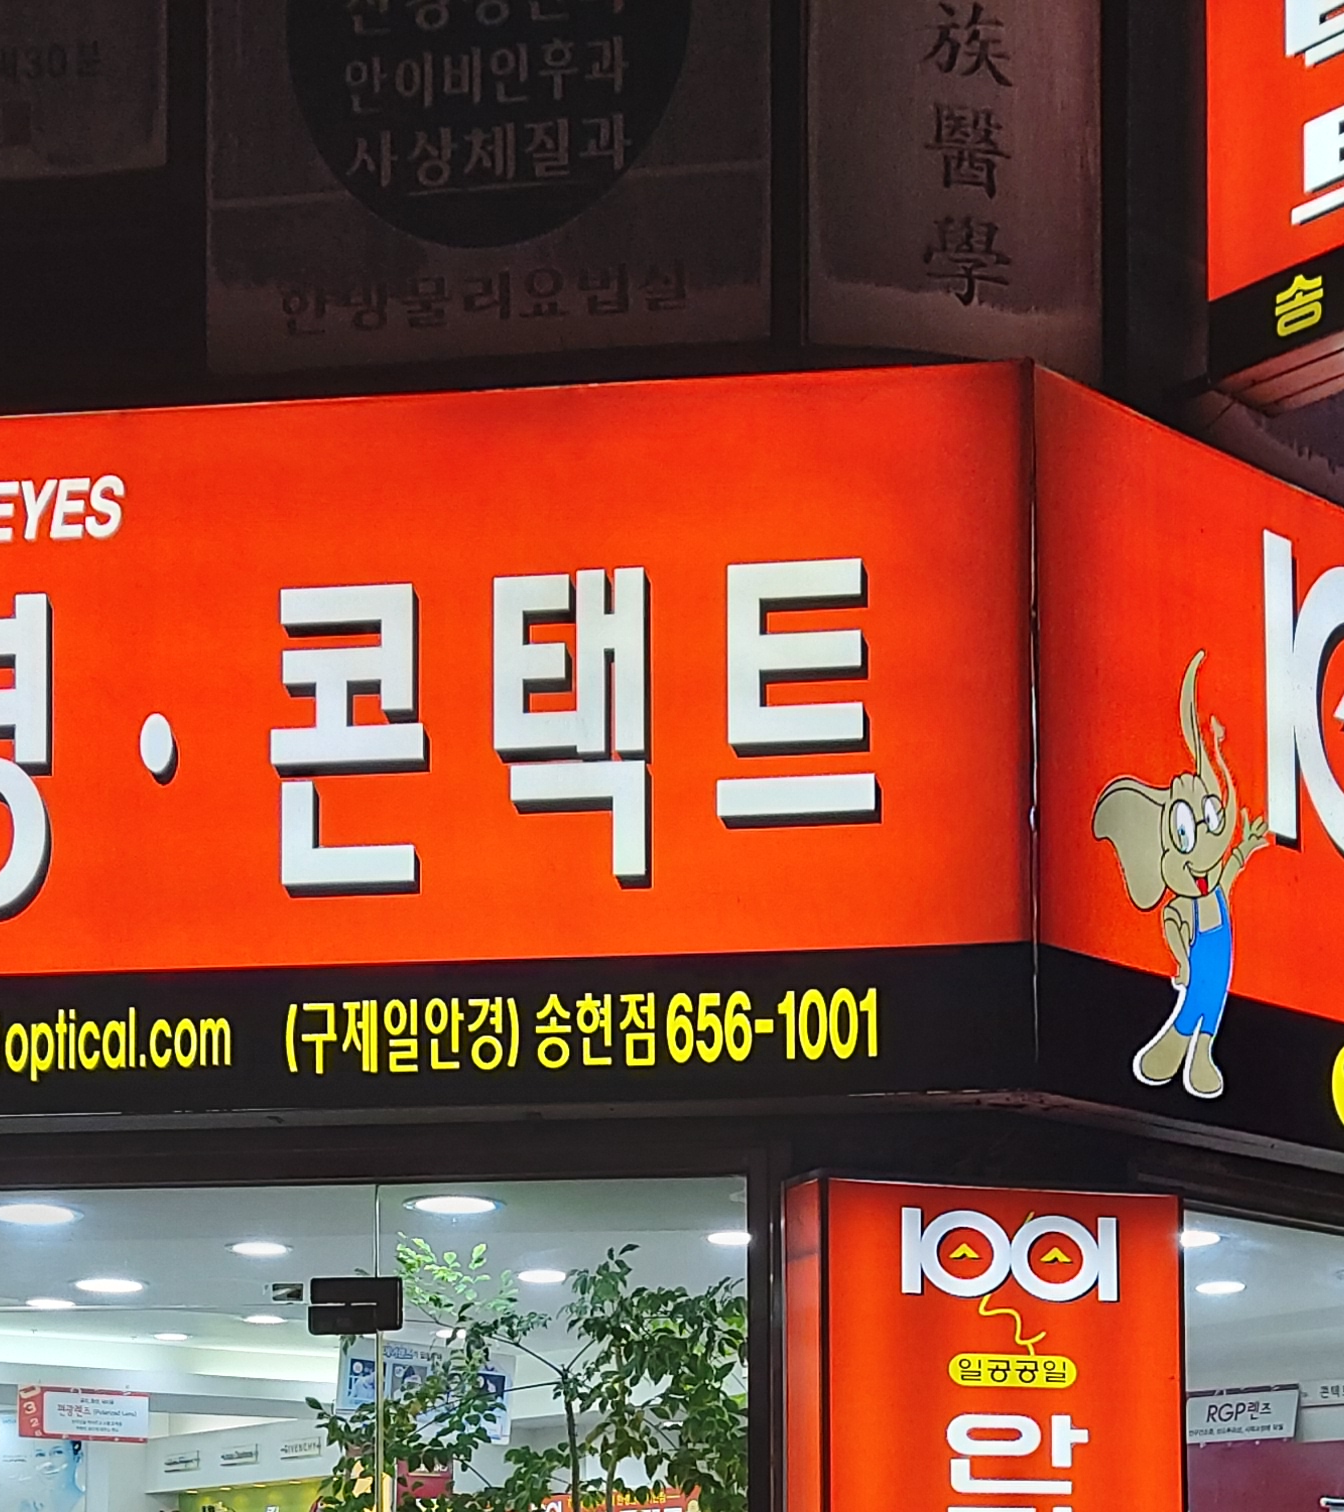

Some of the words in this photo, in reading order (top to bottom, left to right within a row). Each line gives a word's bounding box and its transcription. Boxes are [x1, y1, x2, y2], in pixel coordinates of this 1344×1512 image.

[346, 112, 633, 188] 사상체질과
[286, 999, 519, 1074] (구제일안경)
[536, 991, 655, 1069] 송현점
[665, 987, 878, 1064] 656-1001
[902, 1207, 1117, 1301] 1001
[957, 1356, 1067, 1384] 일공공일
[1206, 1400, 1272, 1423] RGP렌즈
